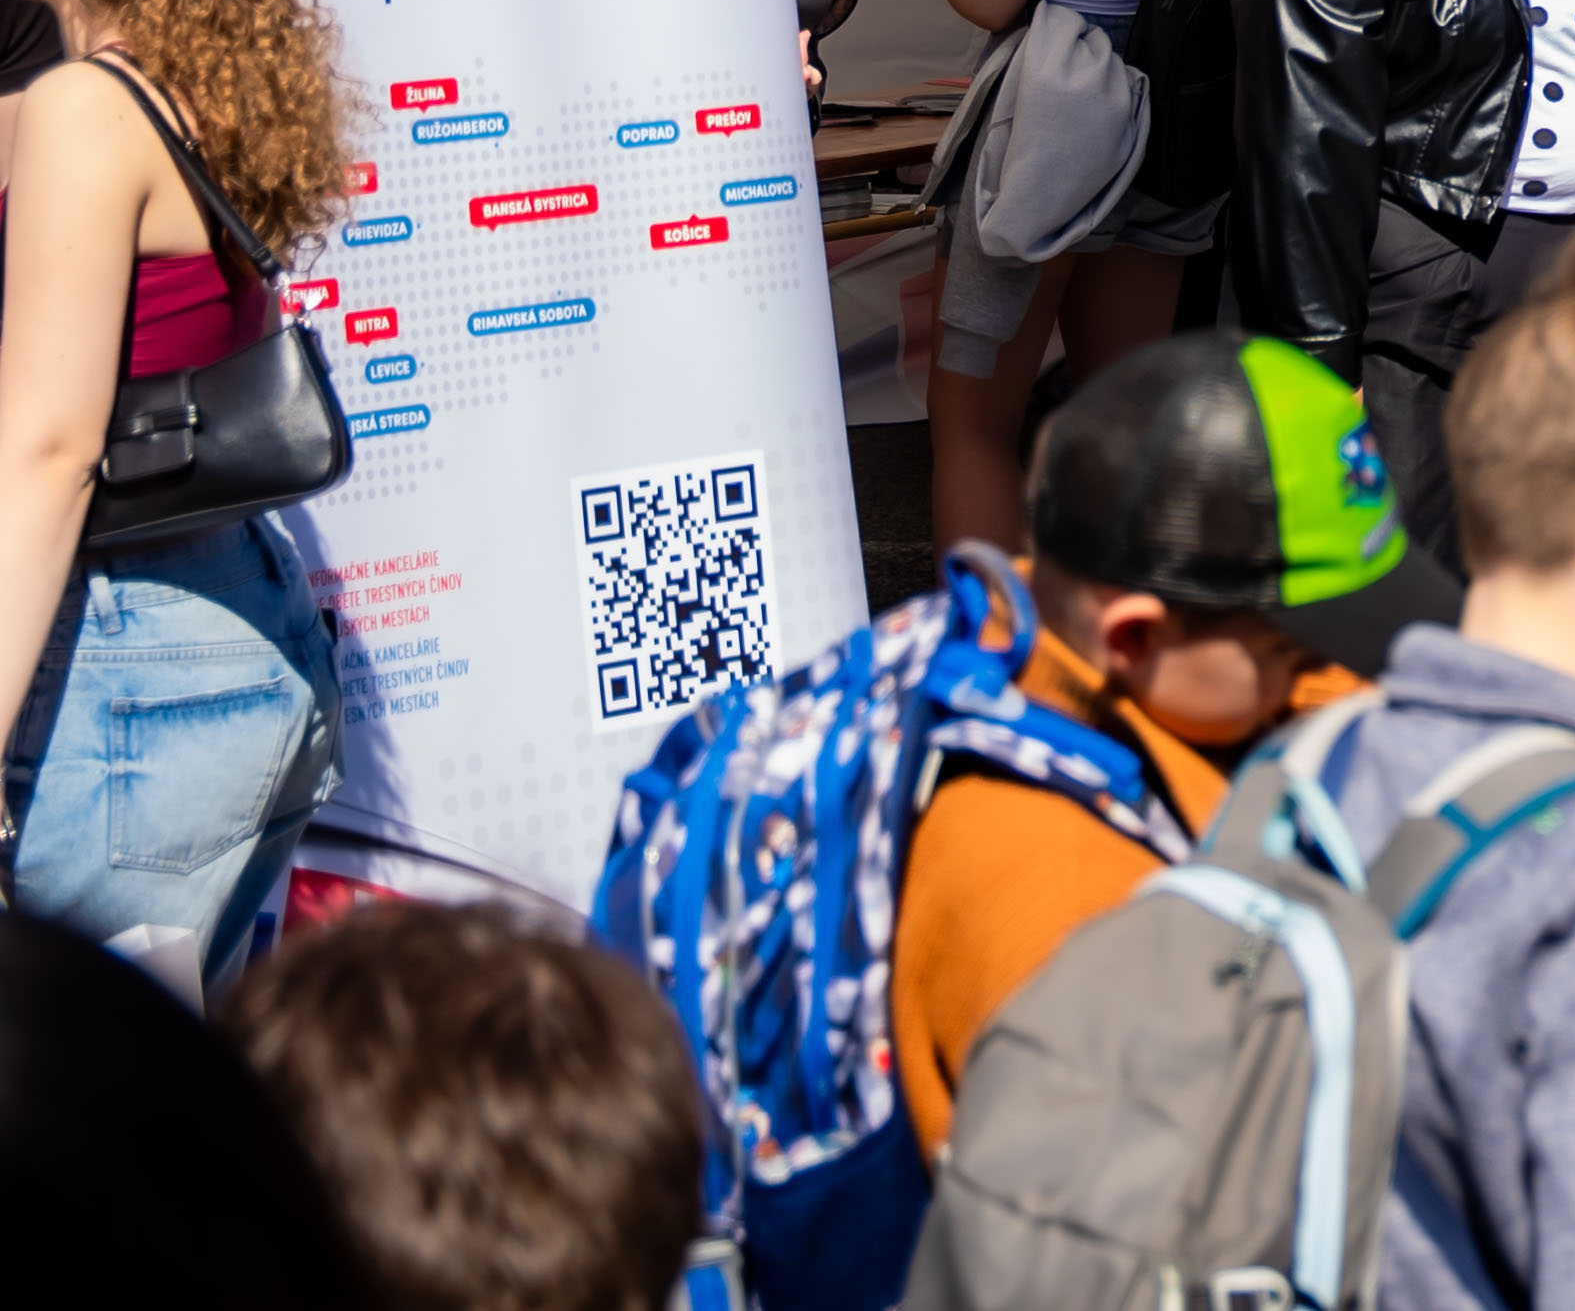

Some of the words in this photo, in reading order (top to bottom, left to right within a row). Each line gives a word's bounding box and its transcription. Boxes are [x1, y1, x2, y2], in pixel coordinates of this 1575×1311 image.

[406, 85, 446, 104] ŽILINA
[417, 117, 505, 140] RUŽOMBEROK
[706, 108, 752, 128] PREŠOV
[622, 123, 675, 144] POPRAD
[725, 179, 793, 202] MICHALOVCE
[483, 195, 531, 219] BANSKÁ
[534, 191, 589, 214] BYSTRICA
[347, 221, 408, 242] PRIEVIDZA
[664, 221, 711, 244] KOŠICE
[354, 315, 390, 334] NITRA
[472, 306, 537, 333] RIMAVSKÁ
[539, 302, 588, 324] SOBOTA
[370, 360, 411, 379] LEVICE
[379, 410, 427, 429] STREDA
[374, 551, 440, 574] KANCELÁRIE
[365, 579, 427, 603] TRESTNÝCH
[429, 573, 463, 592] ČINOV
[381, 606, 430, 627] MESTÁCH
[375, 638, 440, 662] KANCELÁRIE
[373, 664, 433, 690] TRESTNÝCH
[436, 659, 469, 677] ČINOV
[390, 692, 439, 713] MESTÁCH
